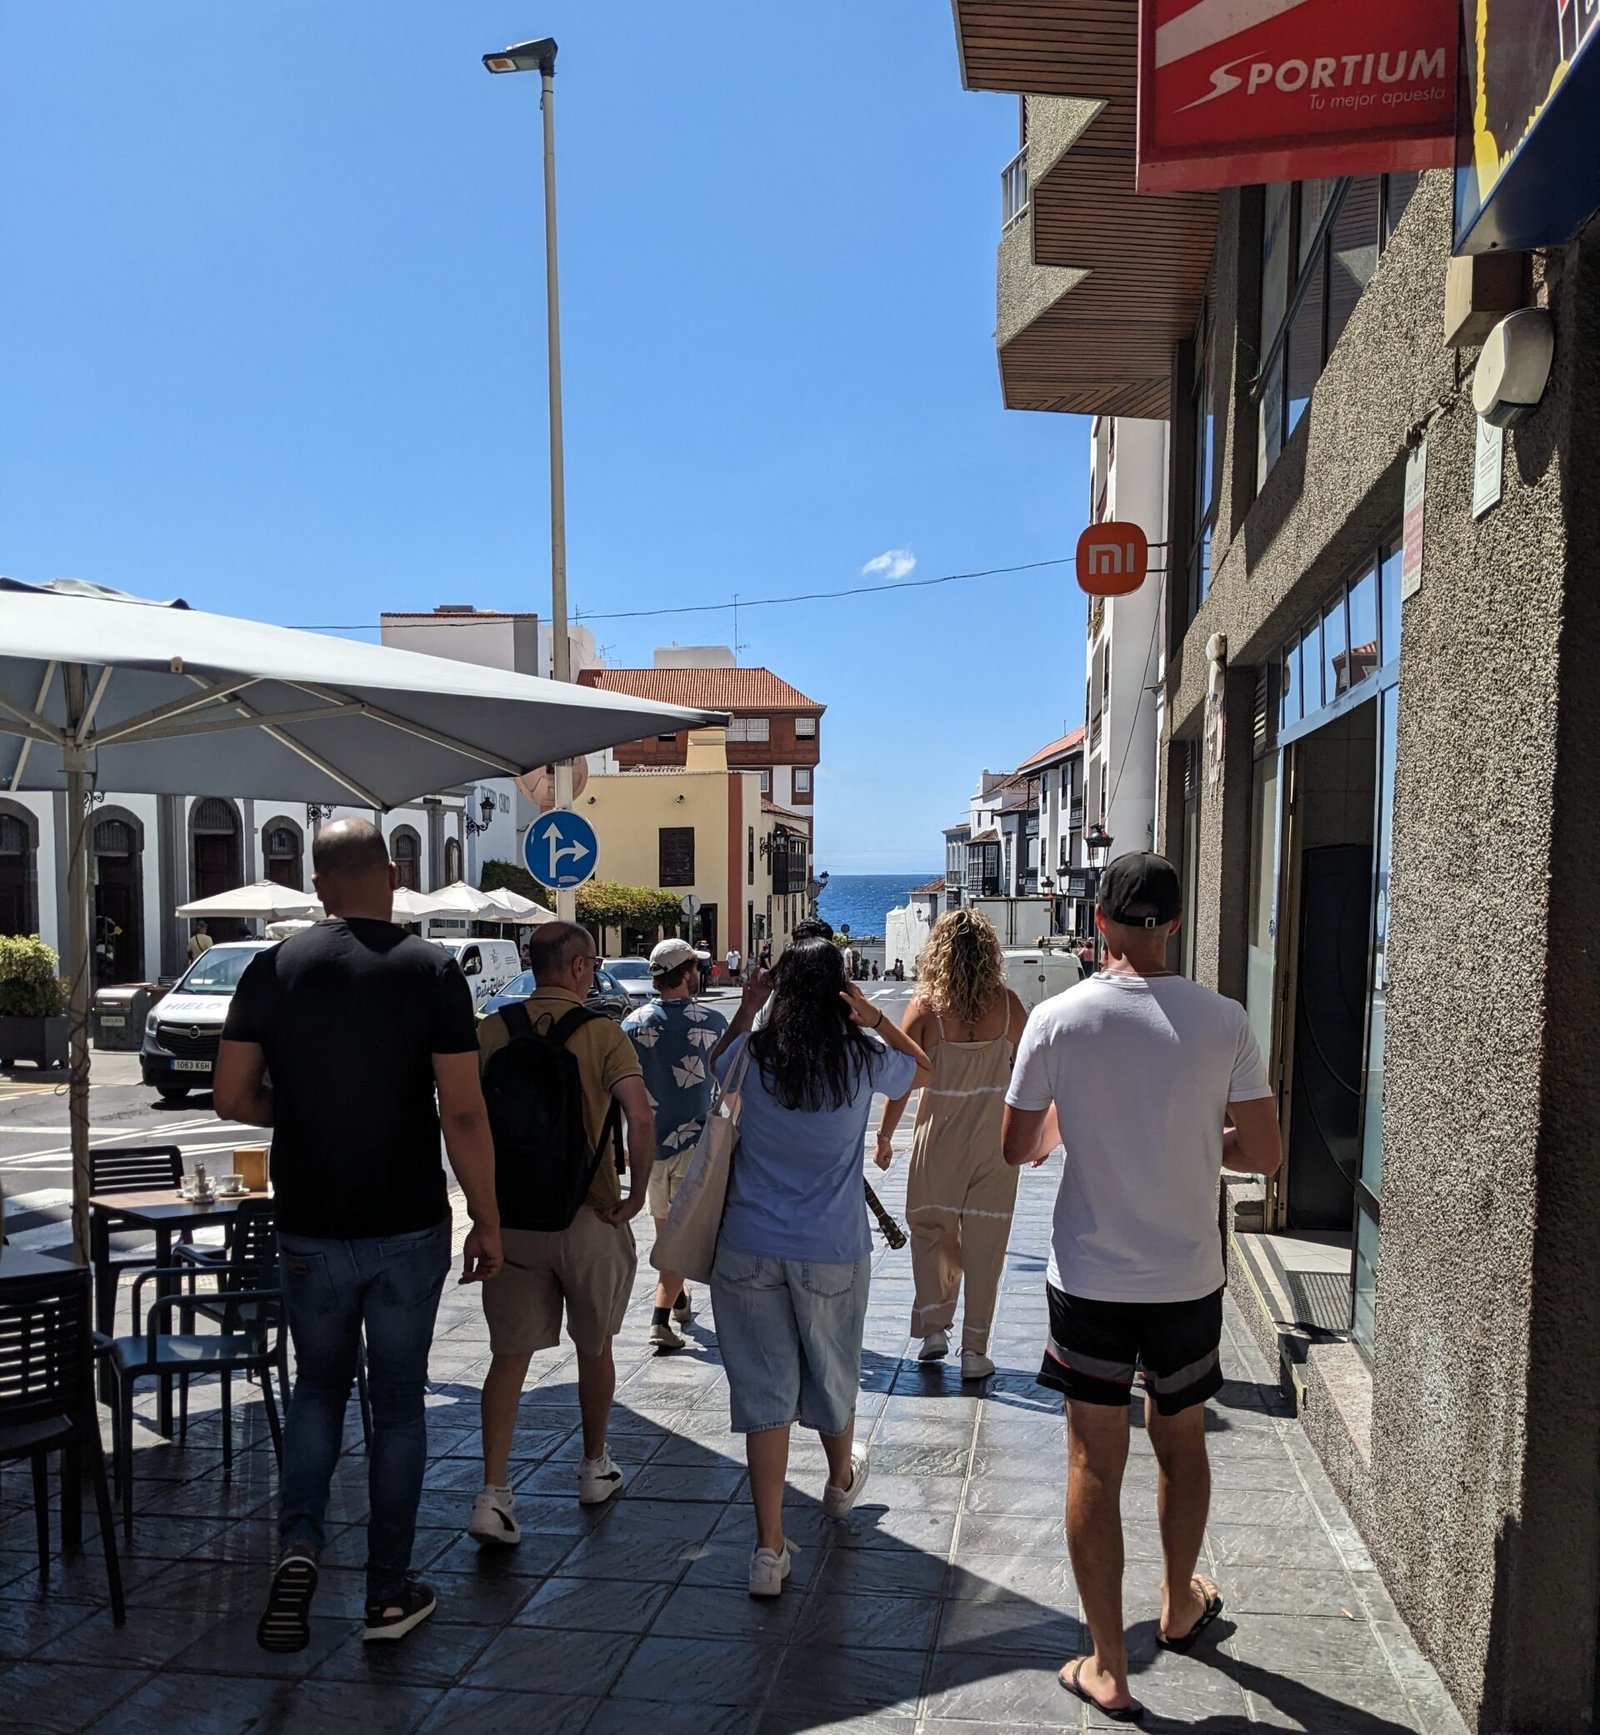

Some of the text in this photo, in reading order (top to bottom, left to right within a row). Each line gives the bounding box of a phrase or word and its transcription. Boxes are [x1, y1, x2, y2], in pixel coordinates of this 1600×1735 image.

[1173, 47, 1447, 114] SPORTIUM
[1310, 87, 1447, 110] Tu mejor apuesta
[162, 1002, 223, 1011] HIELO
[176, 1061, 194, 1069] 1063
